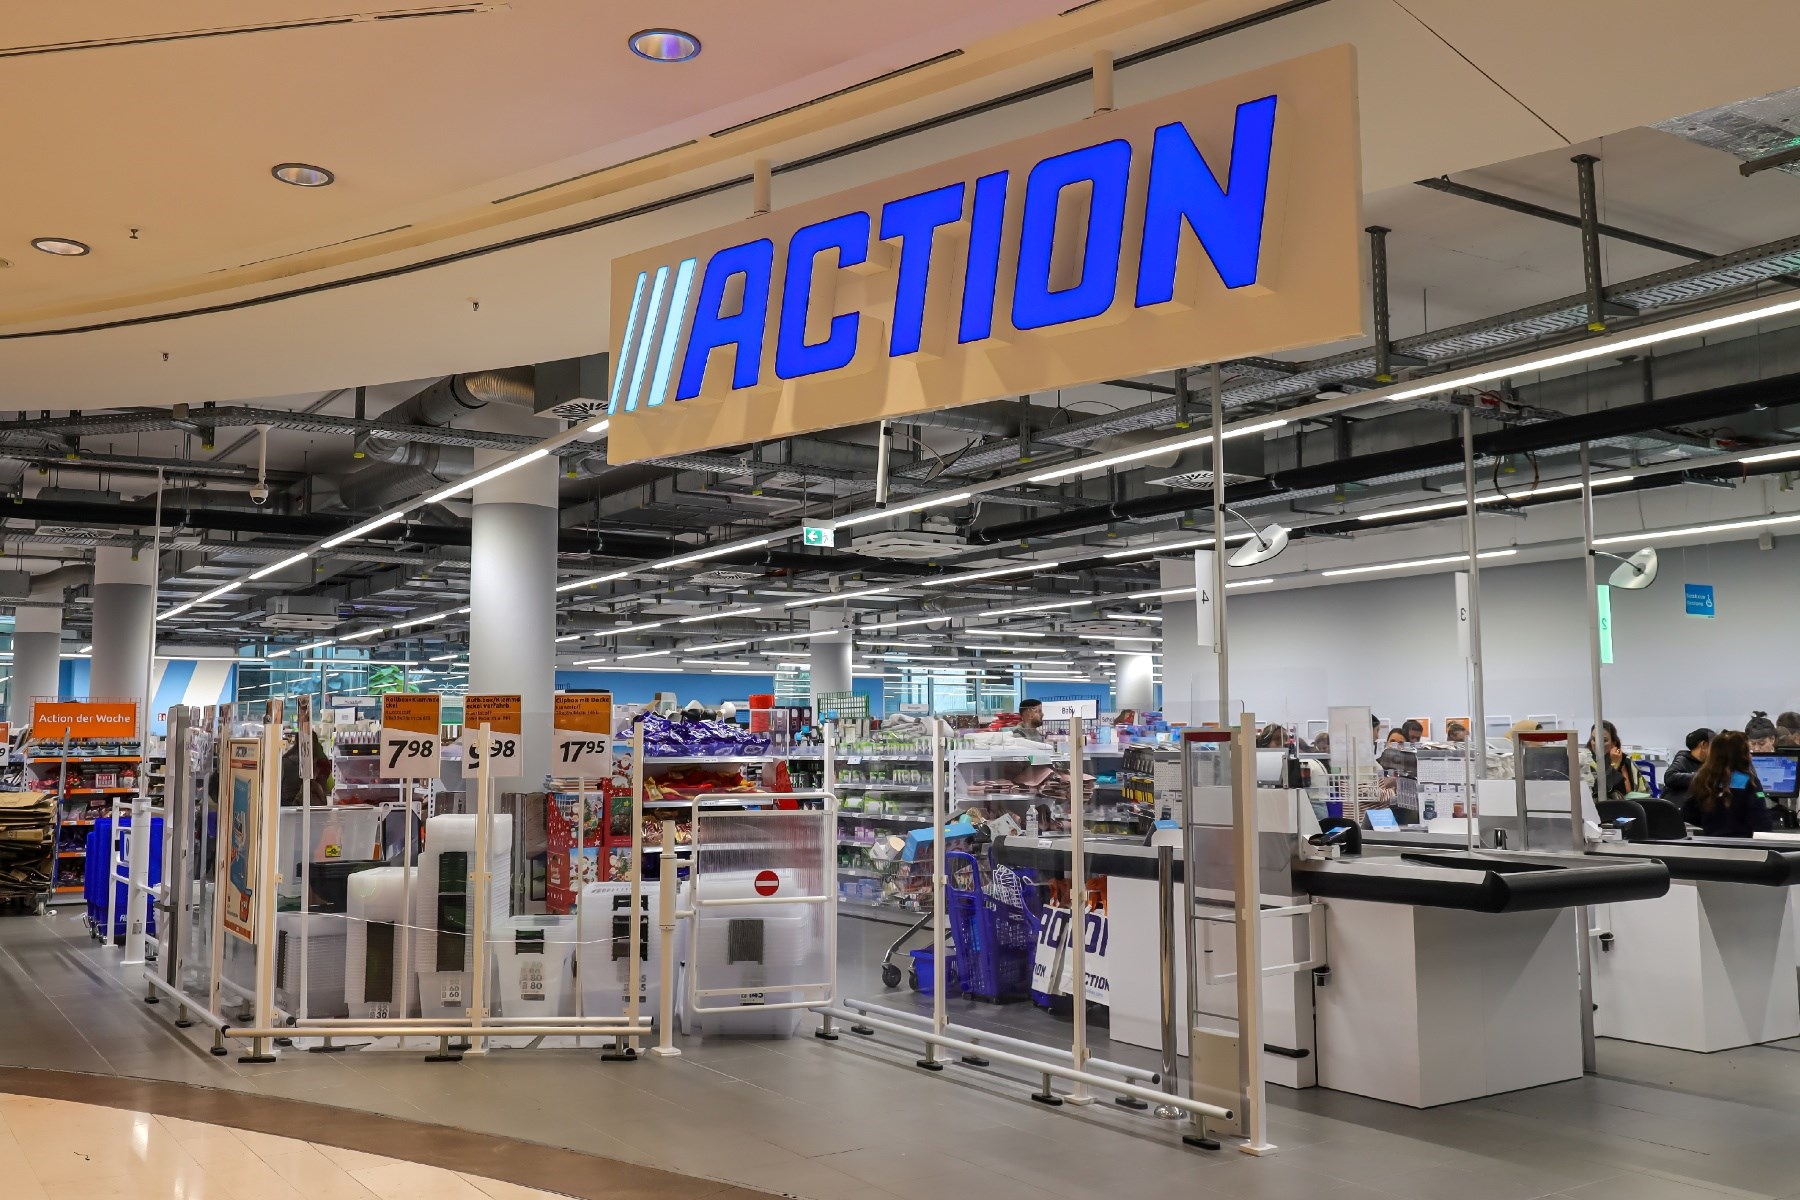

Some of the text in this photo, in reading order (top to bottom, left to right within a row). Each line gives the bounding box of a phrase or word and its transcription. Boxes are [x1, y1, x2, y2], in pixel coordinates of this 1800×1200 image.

[675, 95, 1277, 401] ACTION
[39, 713, 131, 723] Action der Woche
